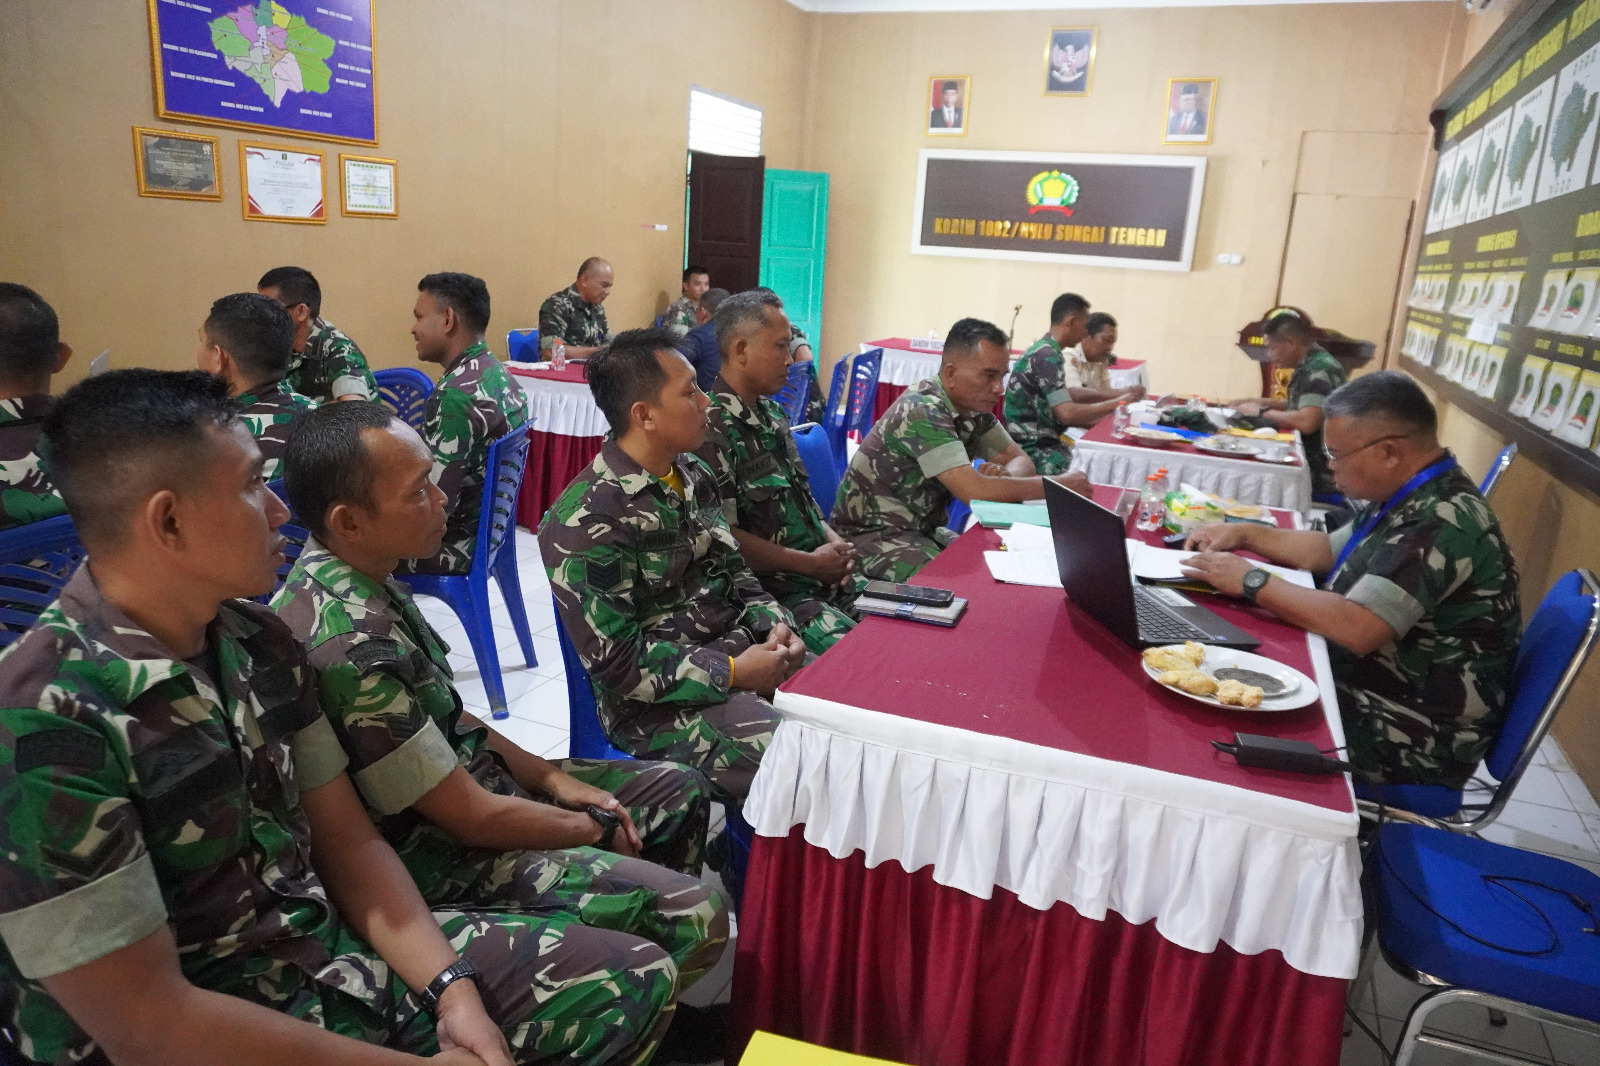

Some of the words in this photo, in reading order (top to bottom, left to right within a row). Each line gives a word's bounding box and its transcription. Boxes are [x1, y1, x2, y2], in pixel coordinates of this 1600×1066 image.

[934, 217, 976, 236] KODIM
[1056, 224, 1105, 244] SUNGAI
[1109, 227, 1167, 248] TENGAH
